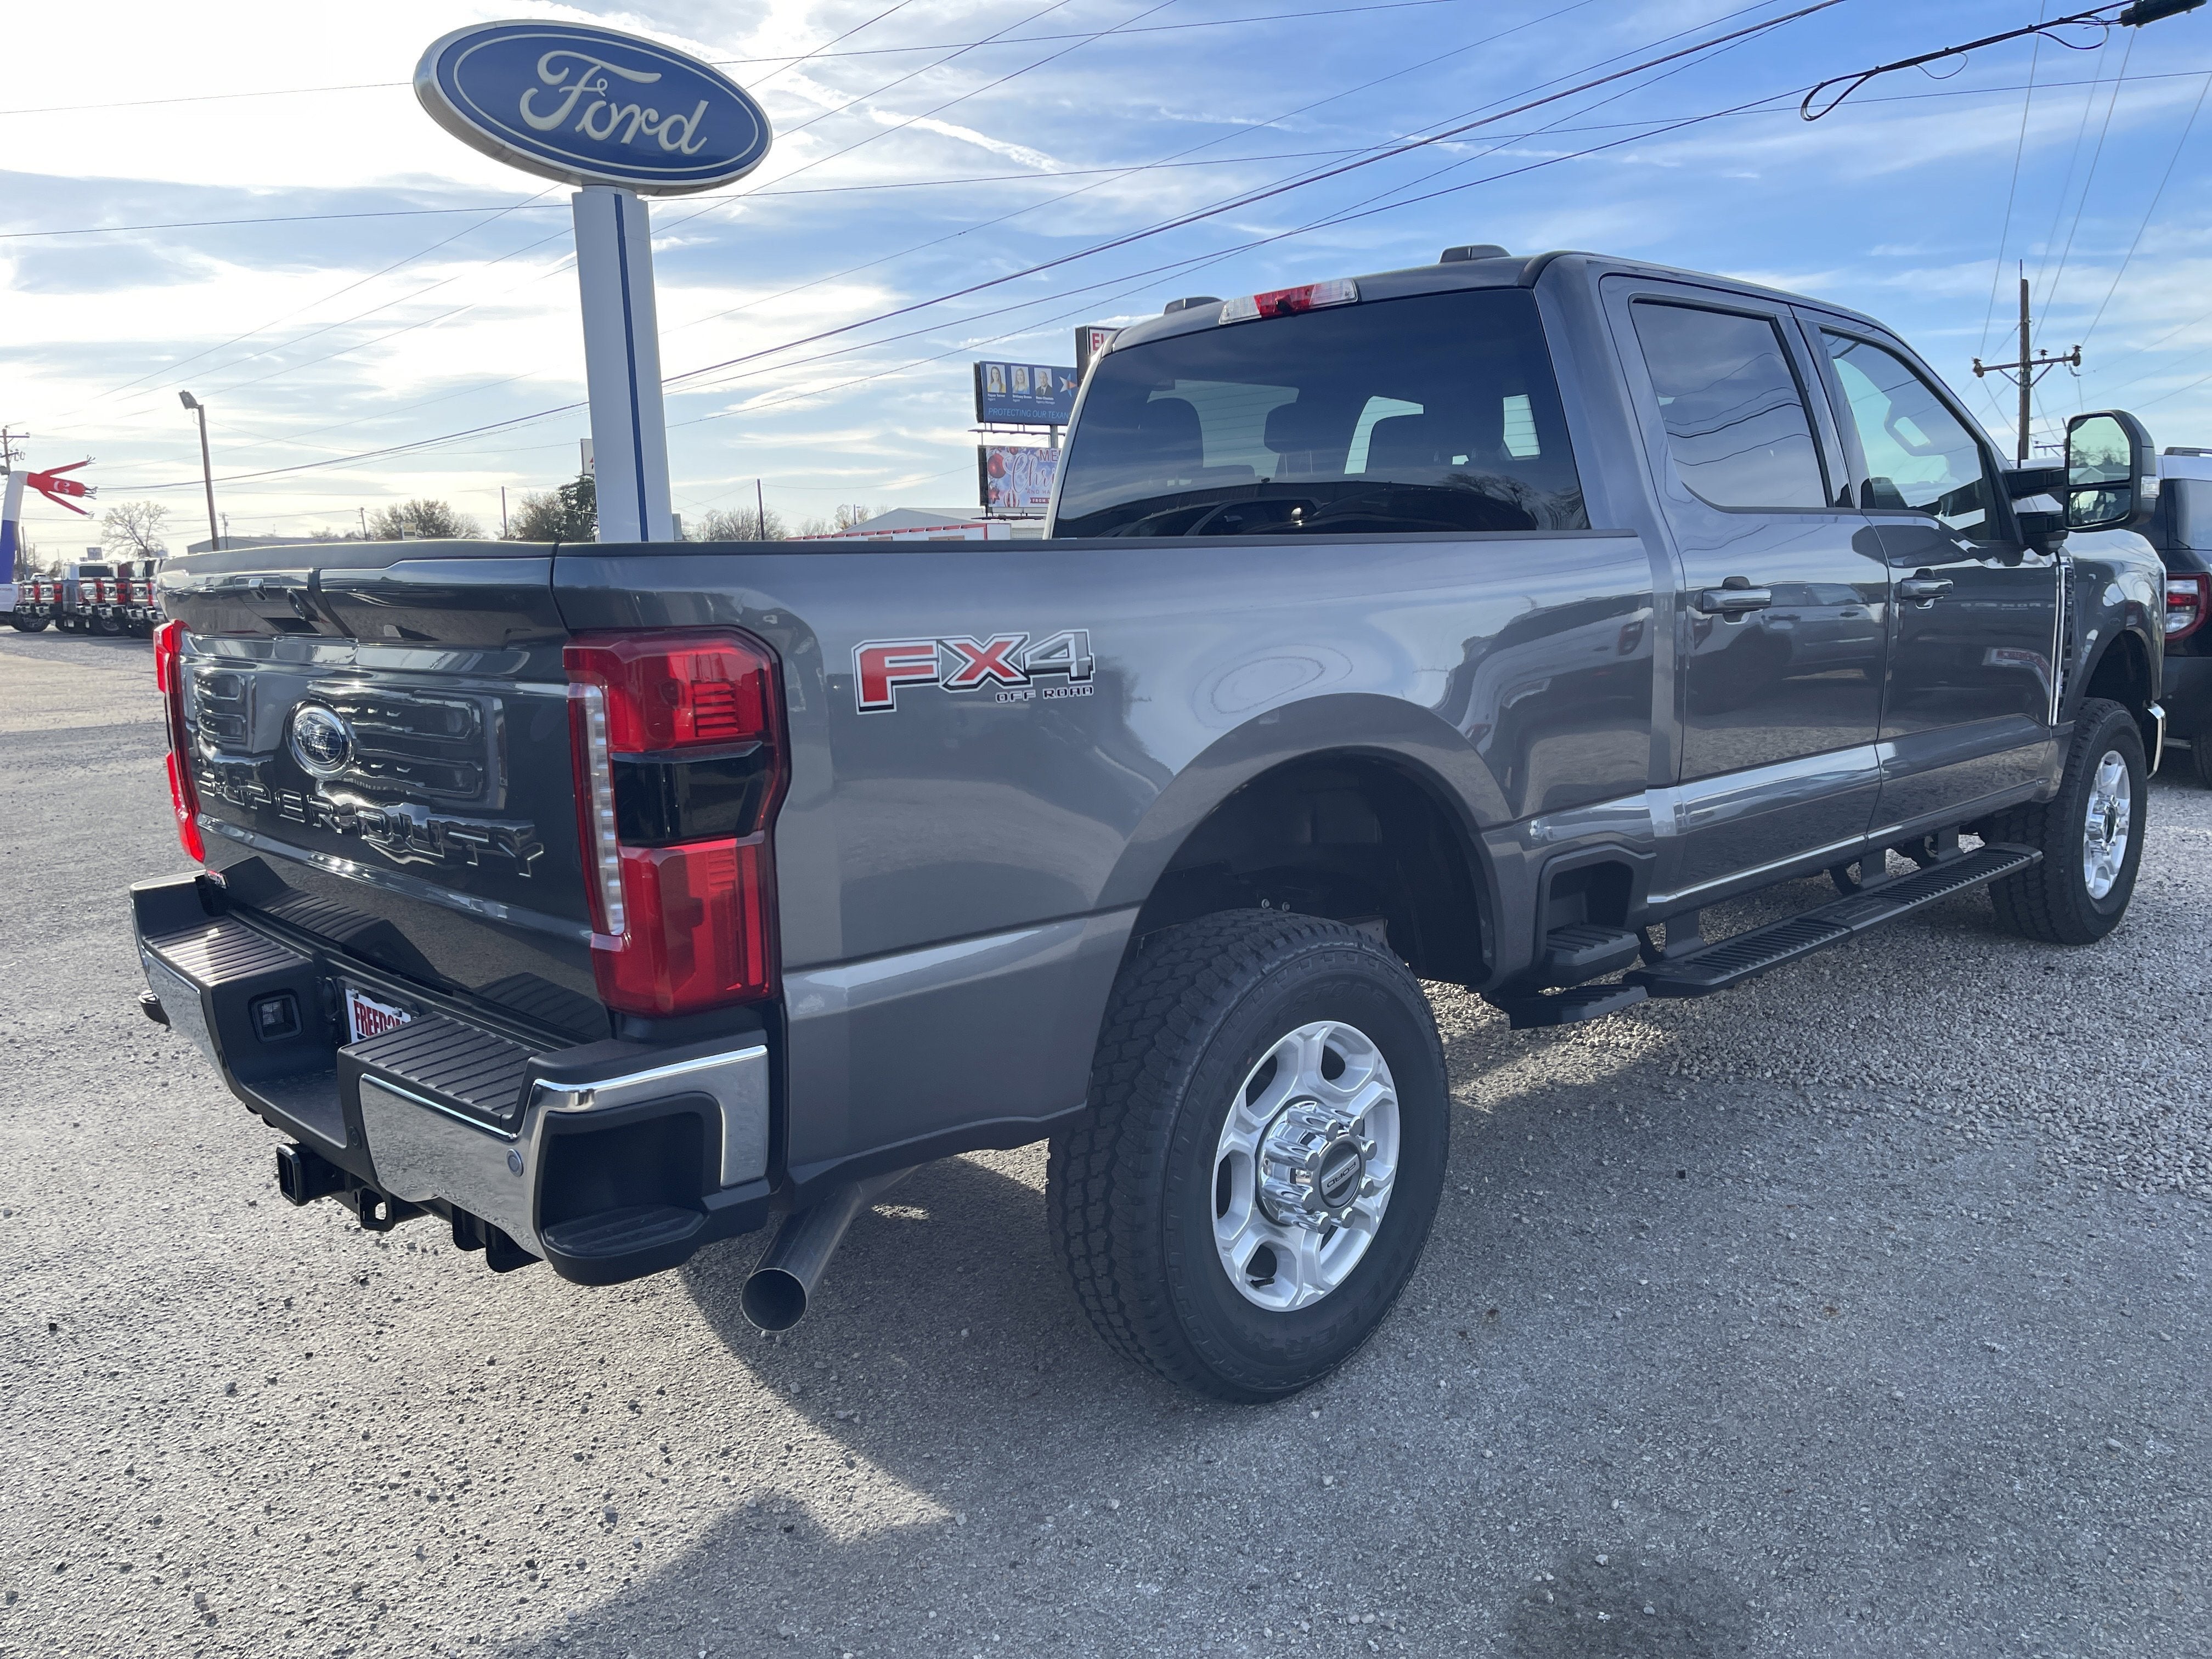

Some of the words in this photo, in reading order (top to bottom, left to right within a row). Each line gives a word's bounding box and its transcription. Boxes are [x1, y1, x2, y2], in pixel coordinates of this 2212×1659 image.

[519, 50, 709, 155] Ford
[988, 408, 1031, 417] PROTECTING
[1040, 449, 1061, 462] ME
[851, 629, 1096, 715] FX4
[995, 689, 1037, 703] OFF
[1043, 685, 1094, 699] ROAD
[353, 1000, 406, 1036] FREED
[1327, 1161, 1356, 1188] FORD
